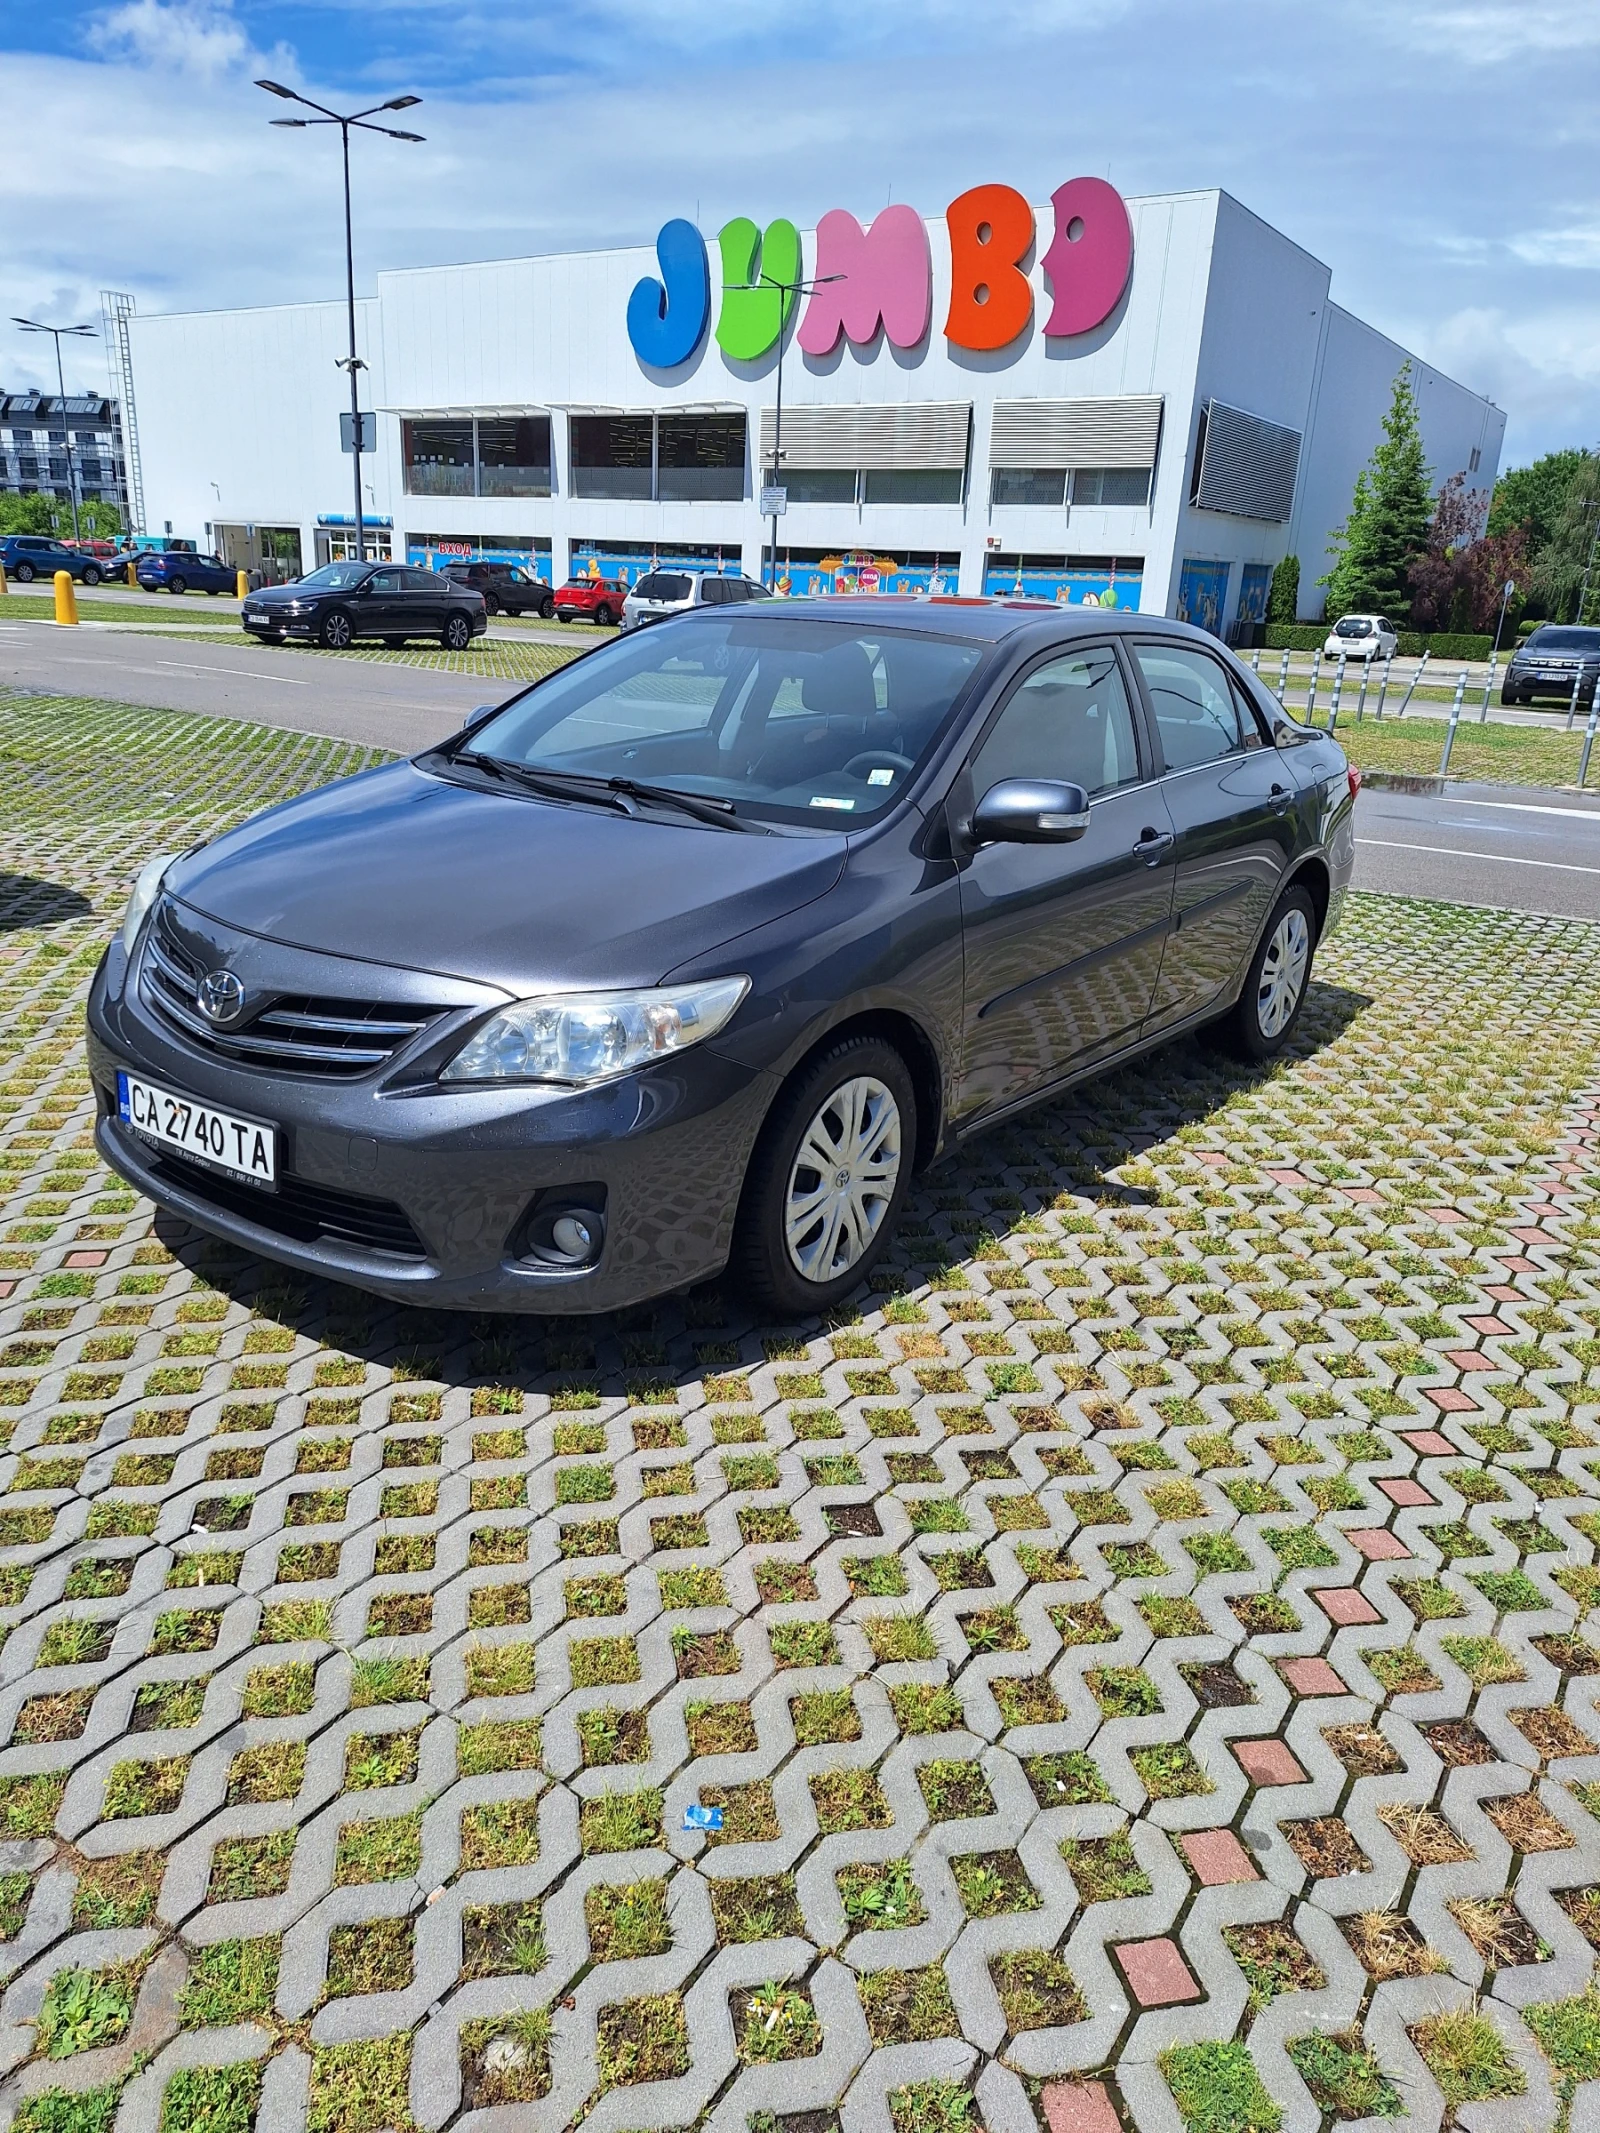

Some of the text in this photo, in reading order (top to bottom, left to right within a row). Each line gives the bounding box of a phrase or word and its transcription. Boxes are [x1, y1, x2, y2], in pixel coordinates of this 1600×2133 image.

[626, 176, 1135, 368] JUMBO
[438, 541, 472, 559] ВХОД
[842, 554, 875, 566] JUMBO
[862, 573, 878, 581] ВХОД
[120, 1101, 130, 1116] BG
[132, 1084, 270, 1174] CA 2740 TA
[134, 1128, 159, 1148] TOYOTA
